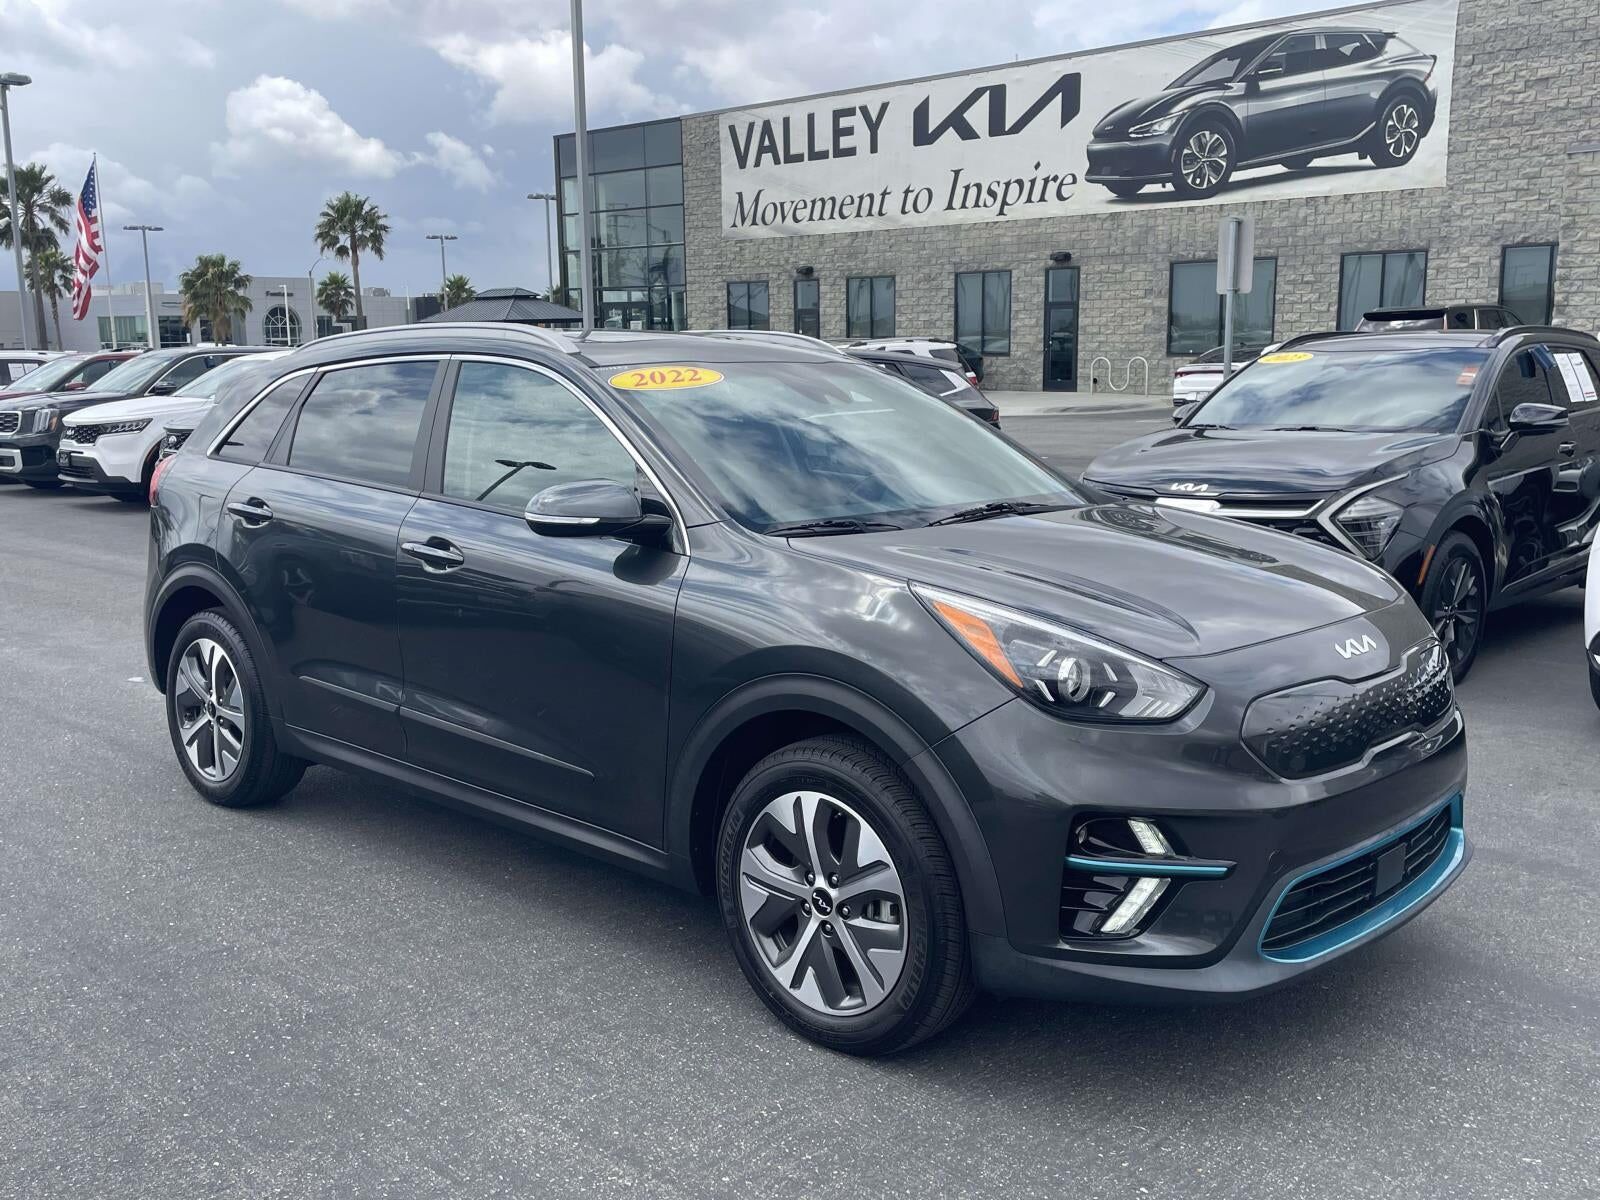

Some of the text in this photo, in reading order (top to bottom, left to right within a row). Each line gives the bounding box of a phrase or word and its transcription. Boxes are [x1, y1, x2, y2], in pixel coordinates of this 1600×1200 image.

[728, 72, 1082, 170] VALLEY KIA
[730, 160, 1078, 228] Movement to Inspire
[631, 369, 702, 387] 2022
[1170, 482, 1208, 492] KIA
[1334, 634, 1377, 659] KIA
